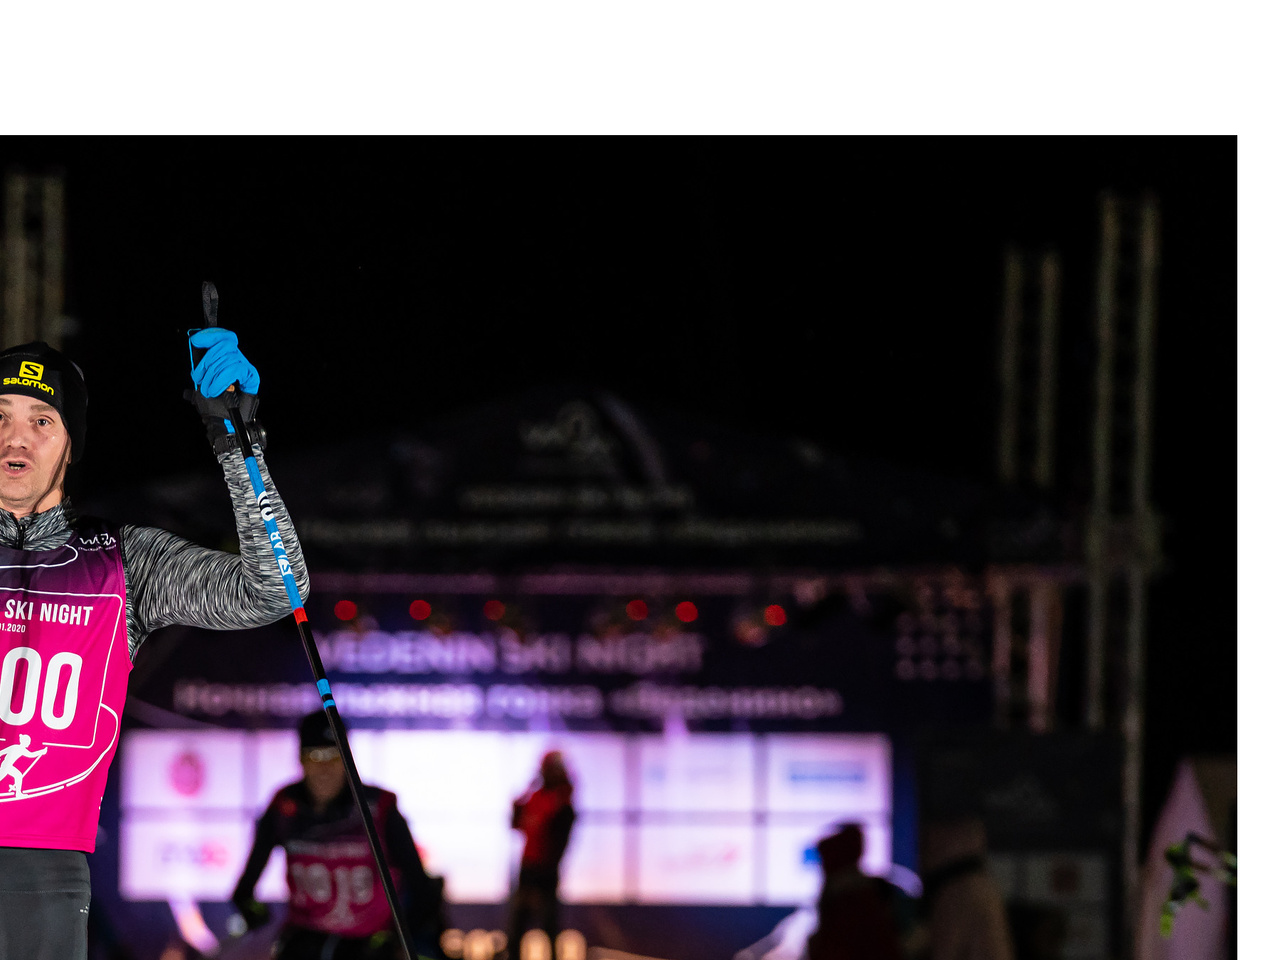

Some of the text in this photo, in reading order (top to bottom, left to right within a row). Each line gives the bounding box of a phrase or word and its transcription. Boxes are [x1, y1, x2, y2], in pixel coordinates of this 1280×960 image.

[2, 377, 55, 396] salomon
[4, 598, 34, 621] SKI
[39, 602, 94, 627] NIGHT
